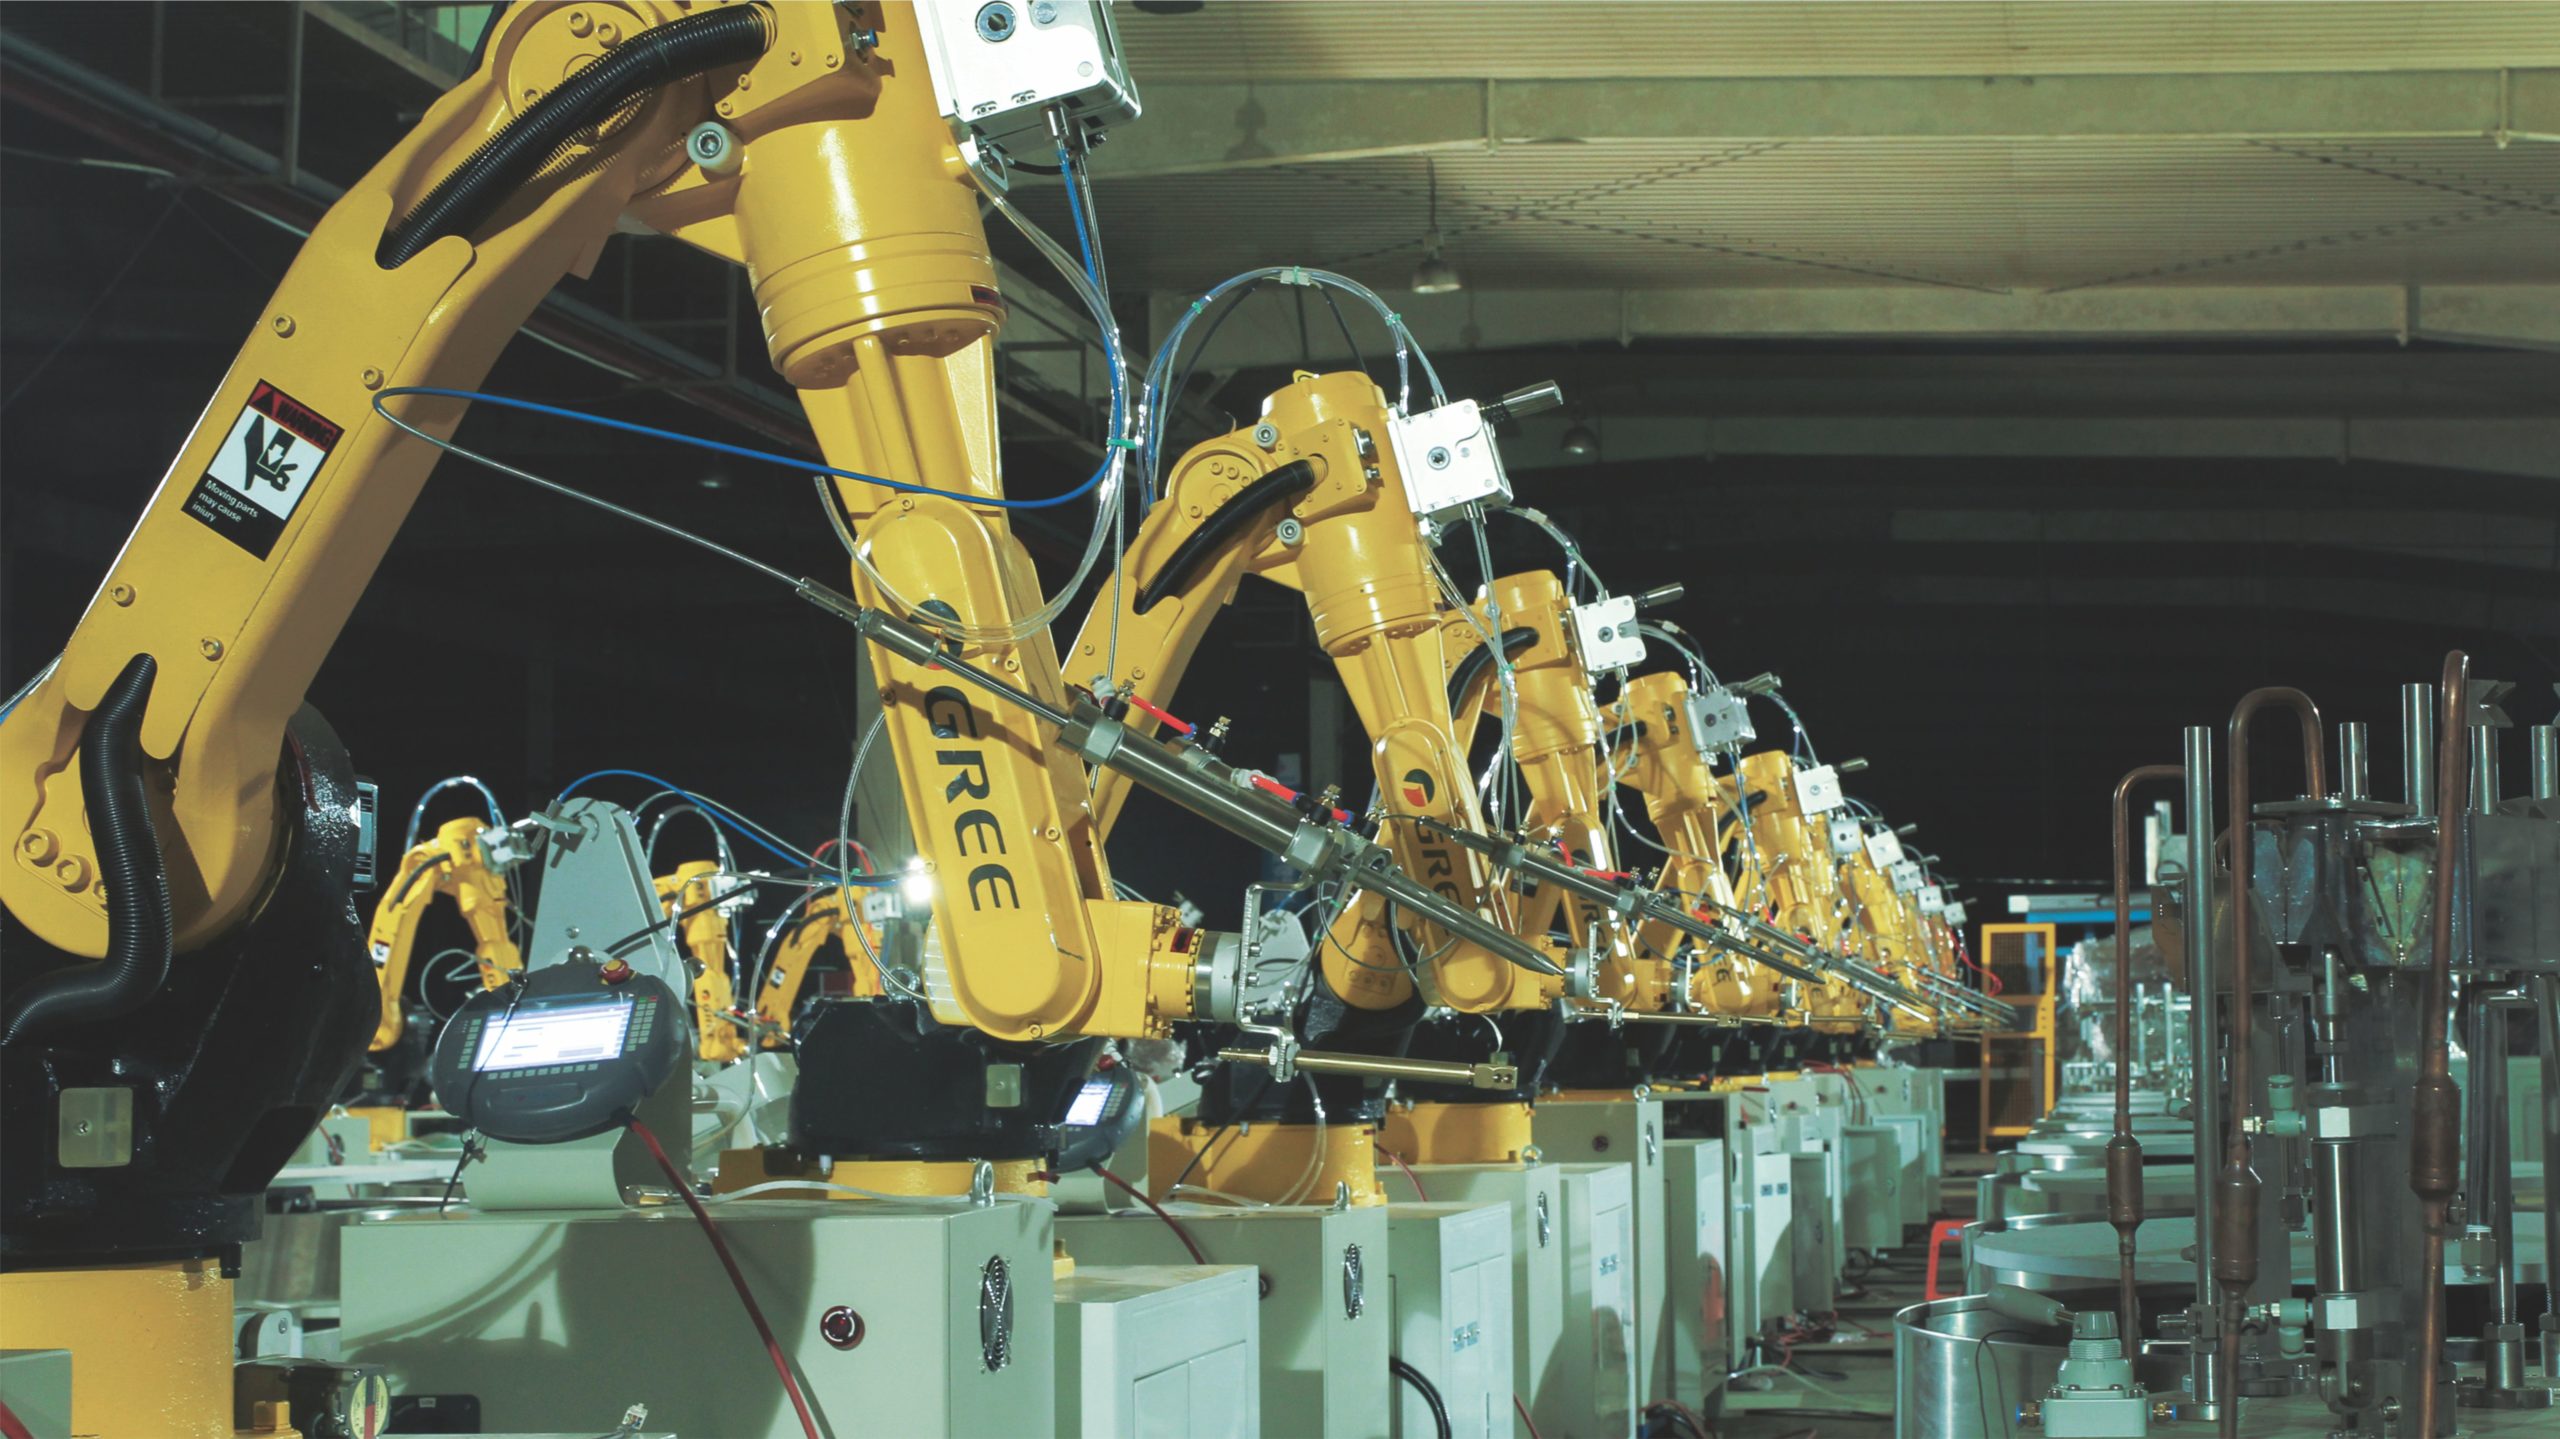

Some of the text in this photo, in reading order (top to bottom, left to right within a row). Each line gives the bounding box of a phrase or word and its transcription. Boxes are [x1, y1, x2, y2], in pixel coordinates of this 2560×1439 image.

[198, 492, 242, 522] may cause
[205, 480, 258, 518] Moving parts
[924, 685, 1020, 911] GREE
[1414, 818, 1464, 937] GRE
